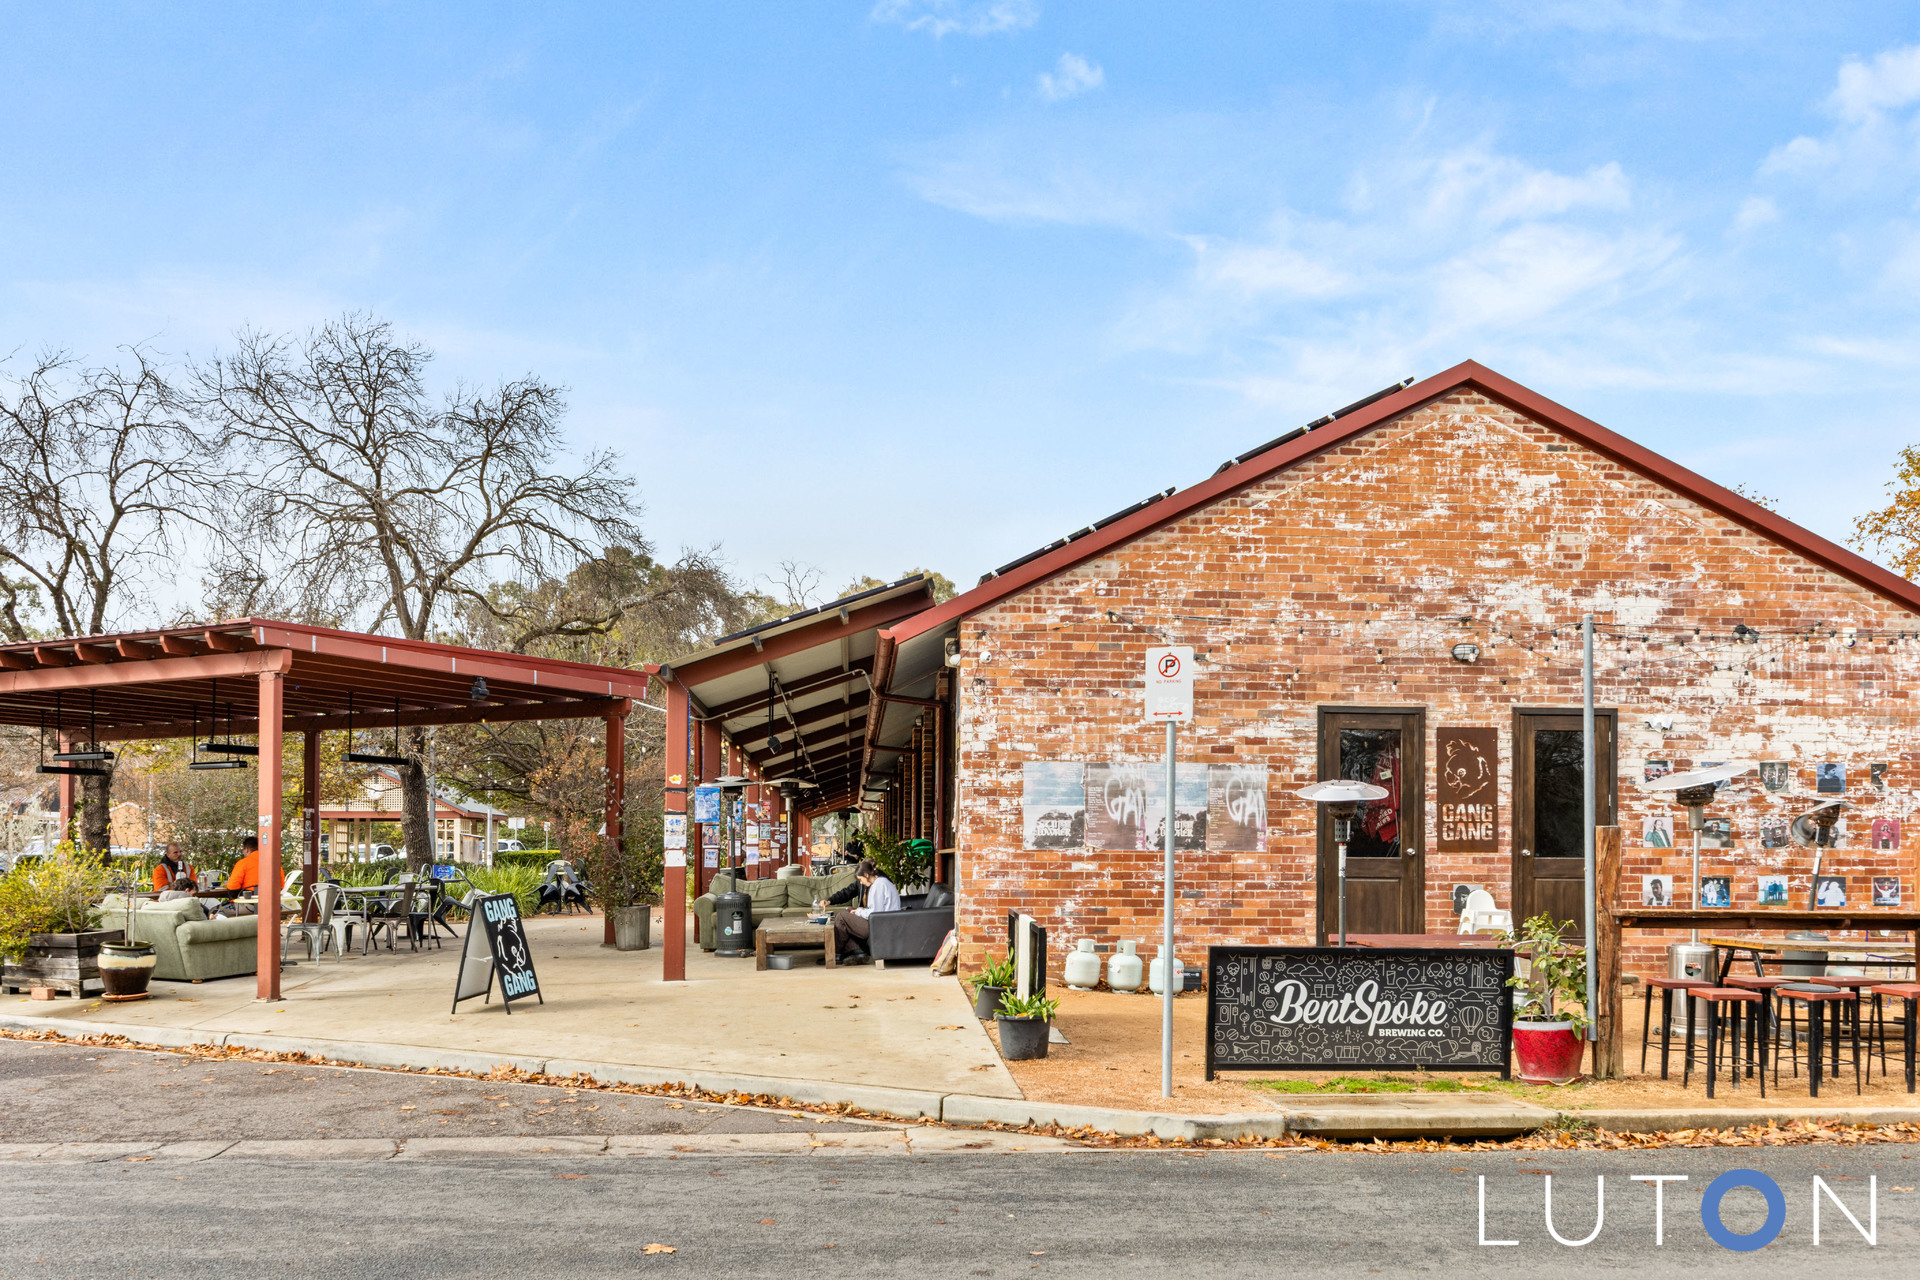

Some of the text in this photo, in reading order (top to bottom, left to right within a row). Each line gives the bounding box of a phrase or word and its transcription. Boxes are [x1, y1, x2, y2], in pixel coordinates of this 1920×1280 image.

[1442, 803, 1493, 822] GANG
[1442, 822, 1493, 841] GANG
[484, 898, 517, 922] GANG
[504, 970, 536, 996] GANG
[1270, 979, 1447, 1036] BentSpoke
[1378, 1028, 1446, 1037] BREWING CO.
